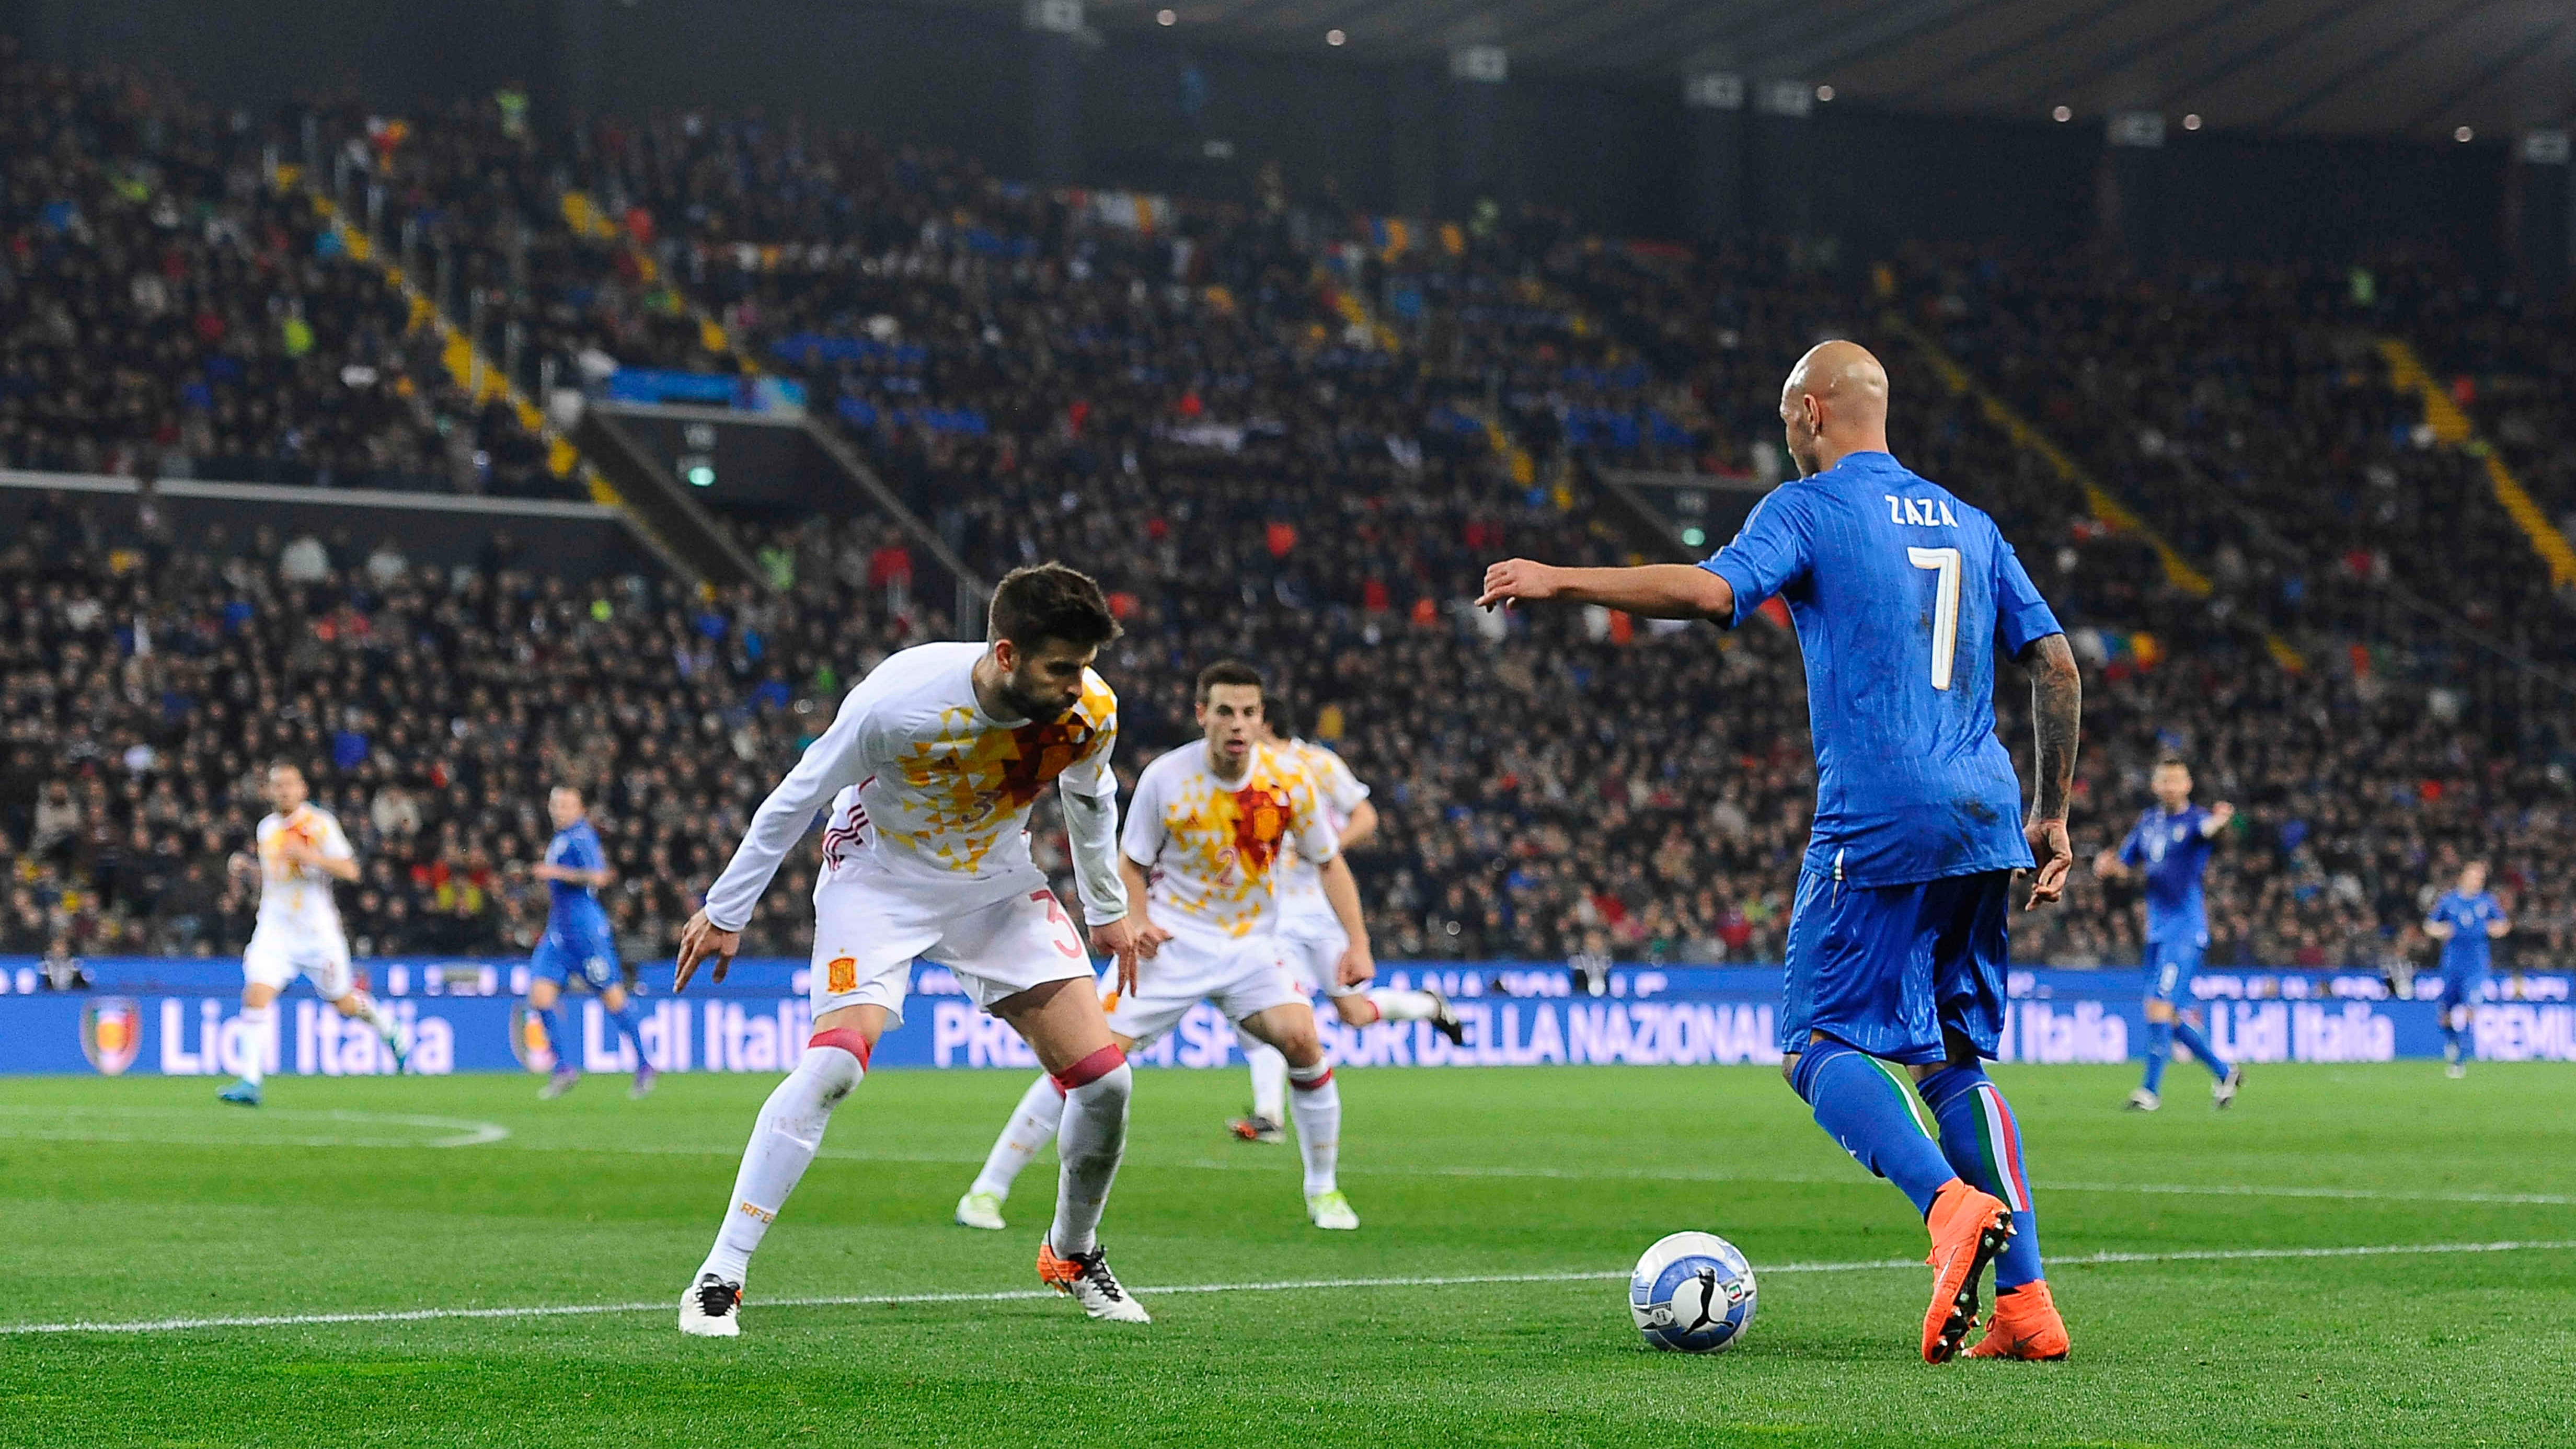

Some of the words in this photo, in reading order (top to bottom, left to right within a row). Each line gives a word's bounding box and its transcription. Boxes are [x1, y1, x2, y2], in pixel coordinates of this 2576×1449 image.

[1885, 494, 1958, 527] ZAZA
[1907, 546, 1961, 691] 7
[1215, 845, 1240, 888] 2
[1029, 889, 1082, 958] 3
[704, 998, 816, 1073] Itali
[1568, 1002, 1784, 1065] NAZIONAL
[2021, 1000, 2129, 1064] Italia
[2210, 1000, 2288, 1063] Lidl
[2293, 1000, 2396, 1063] Italia
